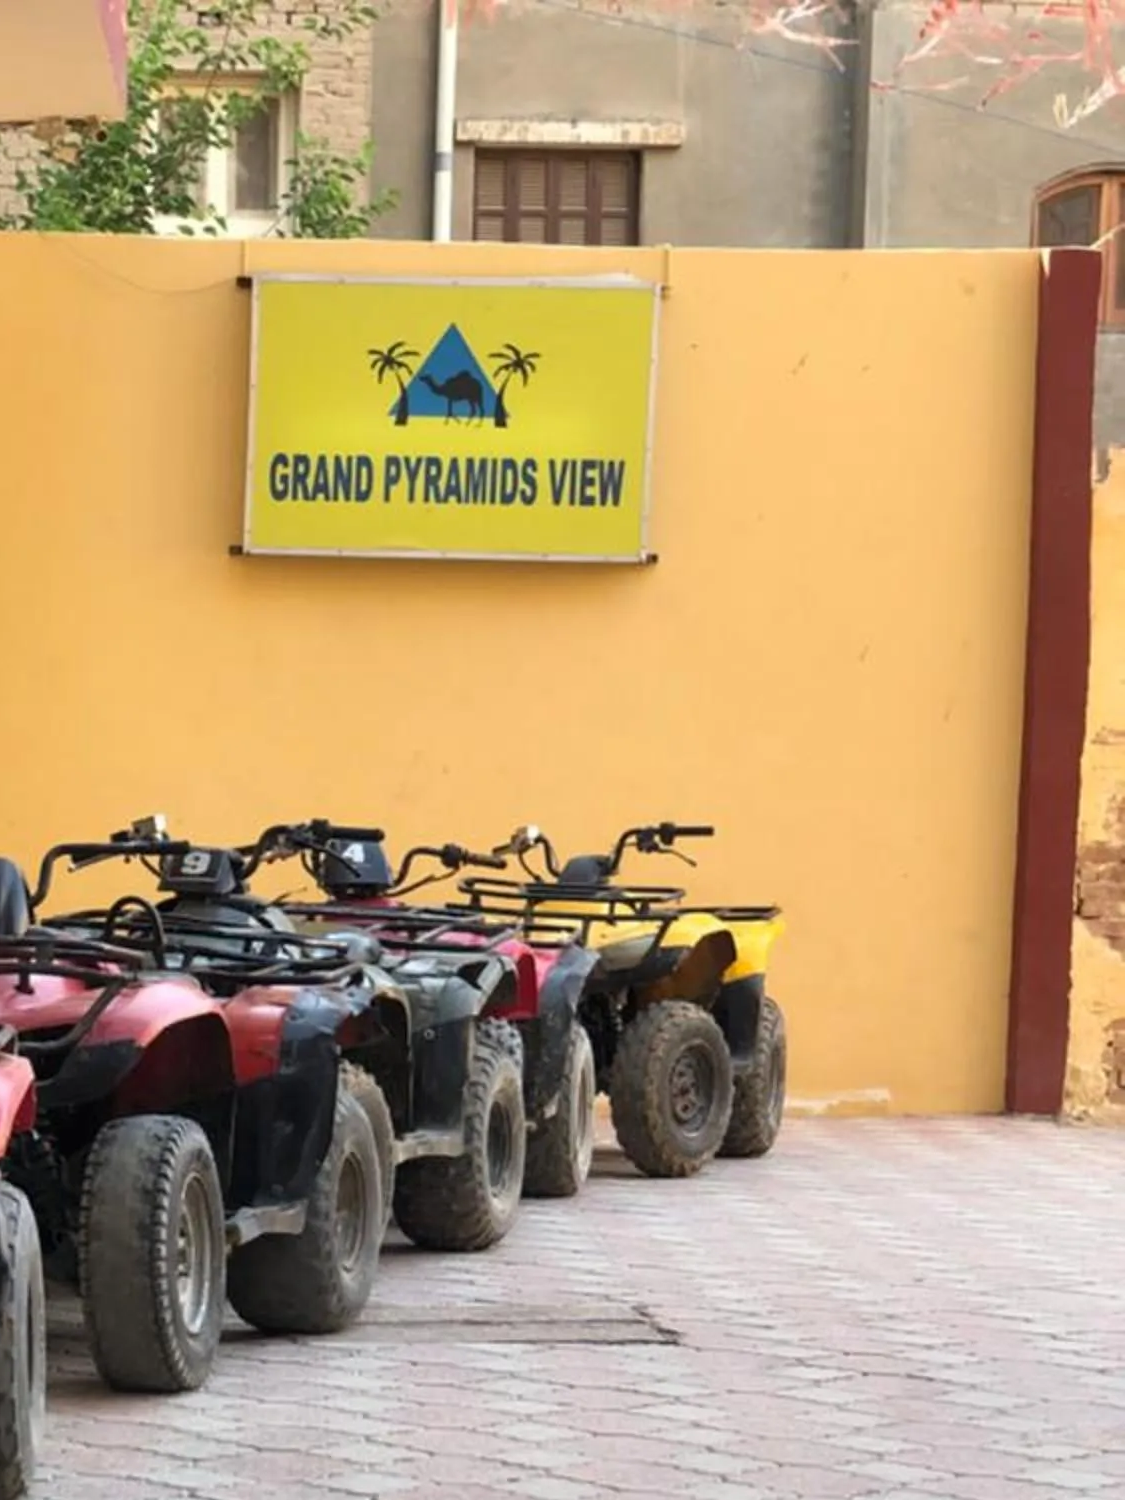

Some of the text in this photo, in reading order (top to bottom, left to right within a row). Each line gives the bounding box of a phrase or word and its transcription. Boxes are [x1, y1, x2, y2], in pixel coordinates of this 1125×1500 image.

[269, 453, 625, 507] GRAND PYRAMIDS VIEW
[180, 851, 211, 875] 9
